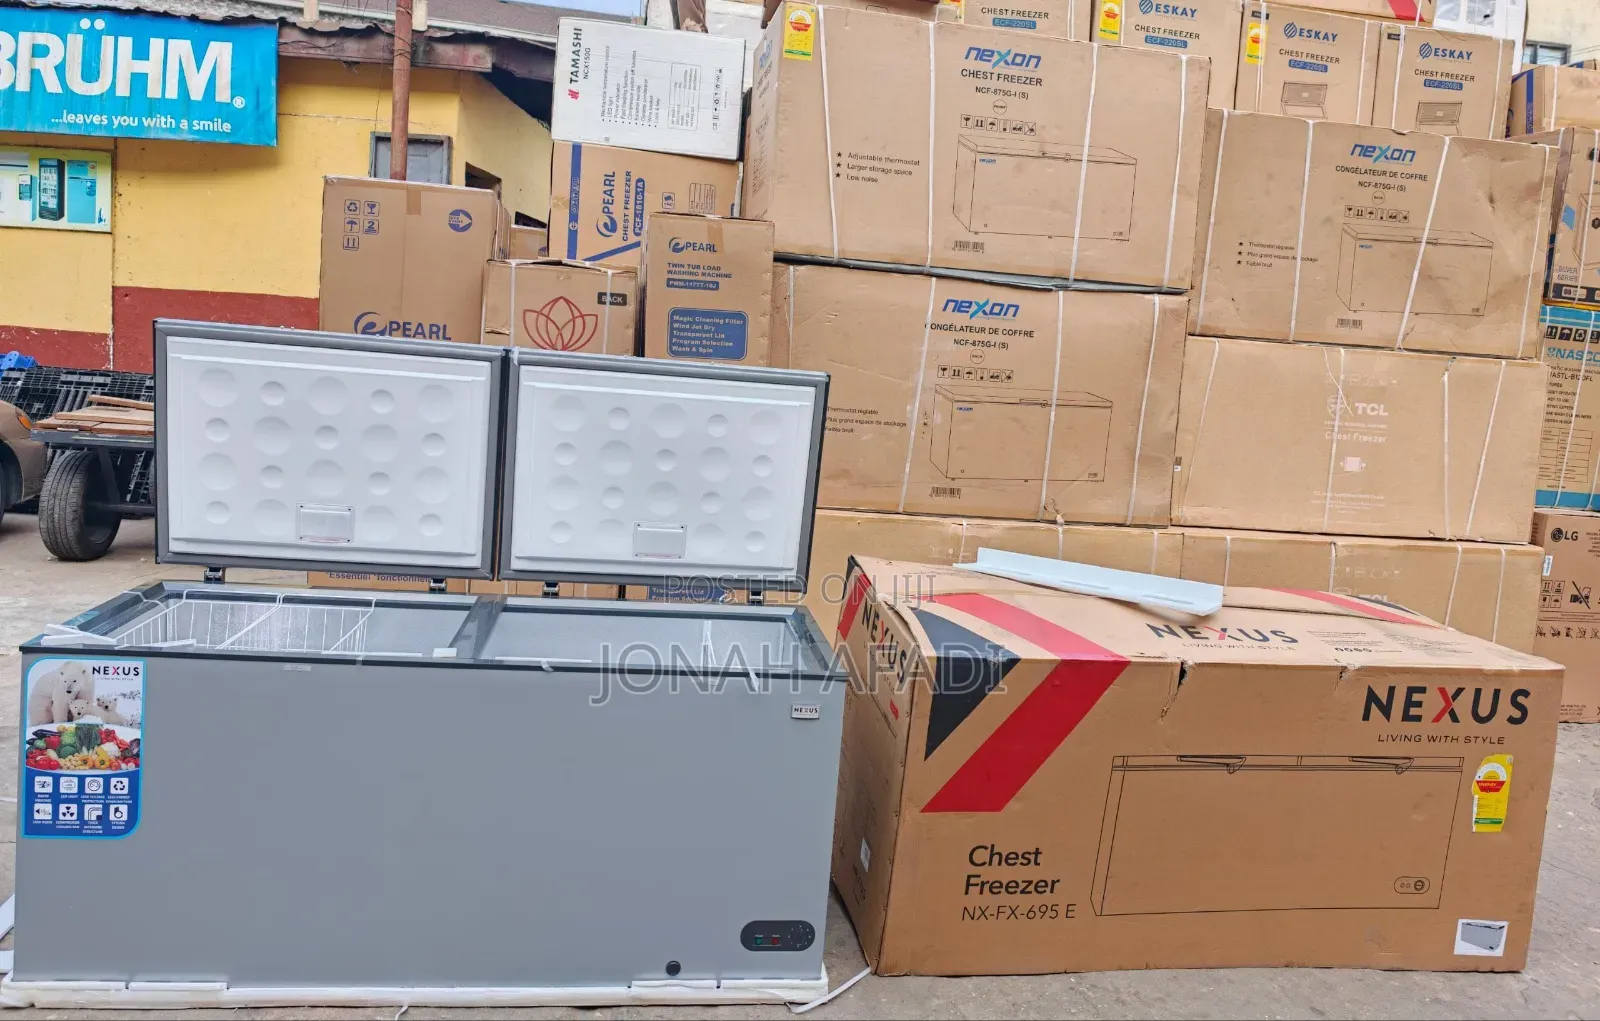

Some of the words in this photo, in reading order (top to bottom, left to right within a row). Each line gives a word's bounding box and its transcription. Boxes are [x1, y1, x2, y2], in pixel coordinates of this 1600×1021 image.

[981, 6, 1009, 16] CHEST
[1010, 9, 1049, 19] FREEZER
[1155, 3, 1198, 18] ESKAY
[994, 18, 1035, 28] ECF-220SL
[1134, 24, 1161, 34] CHEST
[1163, 28, 1200, 40] FREEZER
[1298, 27, 1339, 42] ESKAY
[1146, 36, 1186, 48] ECF-220SL
[569, 27, 583, 85] TAMASHI
[1278, 48, 1304, 58] CHEST
[1305, 53, 1341, 64] FREEZER
[1433, 47, 1473, 60] ESKAY
[583, 47, 591, 80] NCX150G
[1290, 61, 1327, 72] ECF-220SL
[960, 68, 995, 80] CHEST
[996, 73, 1043, 86] FREEZER
[1414, 68, 1439, 78] CHEST
[1440, 72, 1475, 82] FREEZER
[1425, 80, 1462, 90] ECF-220SL
[975, 86, 1017, 97] NCF-875G-I
[1018, 91, 1029, 100] (S)
[51, 109, 109, 124] ...leaves
[111, 115, 138, 129] you
[142, 114, 176, 129] with
[179, 119, 188, 130] a
[192, 117, 232, 133] smile
[847, 152, 883, 162] Adjustable
[884, 156, 920, 166] thermostat
[847, 162, 868, 172] Larger
[868, 165, 893, 174] storage
[893, 168, 913, 176] space
[1335, 164, 1388, 178] CONGÉLATEUR
[1388, 170, 1399, 179] DE
[1399, 171, 1428, 182] COFFRE
[860, 175, 879, 183] noise
[602, 171, 616, 215] PEARL
[623, 170, 632, 210] FREEZER
[1358, 180, 1396, 191] NCF-875G-I
[1396, 183, 1406, 193] (S)
[635, 181, 644, 233] PCF-1810-1A
[622, 212, 630, 242] CHEST
[685, 241, 718, 253] PEARL
[666, 269, 700, 277] WASHING
[700, 271, 733, 279] MACHINE
[1556, 273, 1578, 282] SERIES
[673, 315, 694, 323] Magic
[695, 316, 724, 324] Cleaning
[388, 320, 451, 341] PEARL
[988, 327, 1000, 335] DE
[1001, 328, 1035, 338] COFFRE
[672, 338, 700, 346] Program
[953, 338, 997, 349] NCF-875G-I
[998, 341, 1009, 351] (S)
[1355, 402, 1388, 416] TCL
[1325, 431, 1351, 441] Cest
[1352, 432, 1387, 443] Freezer
[1564, 530, 1579, 541] LG
[1145, 622, 1299, 644] NEXUS
[862, 597, 907, 685] NEXUS
[92, 665, 140, 677] NEXUS
[1361, 684, 1532, 726] NEXUS
[1377, 734, 1422, 743] LIVING
[1426, 735, 1459, 744] WITH
[1463, 736, 1505, 745] STYLE
[968, 843, 1043, 867] Chest
[964, 874, 1061, 896] Freezer
[961, 903, 1059, 922] NX-FX-695
[1065, 903, 1077, 919] E
